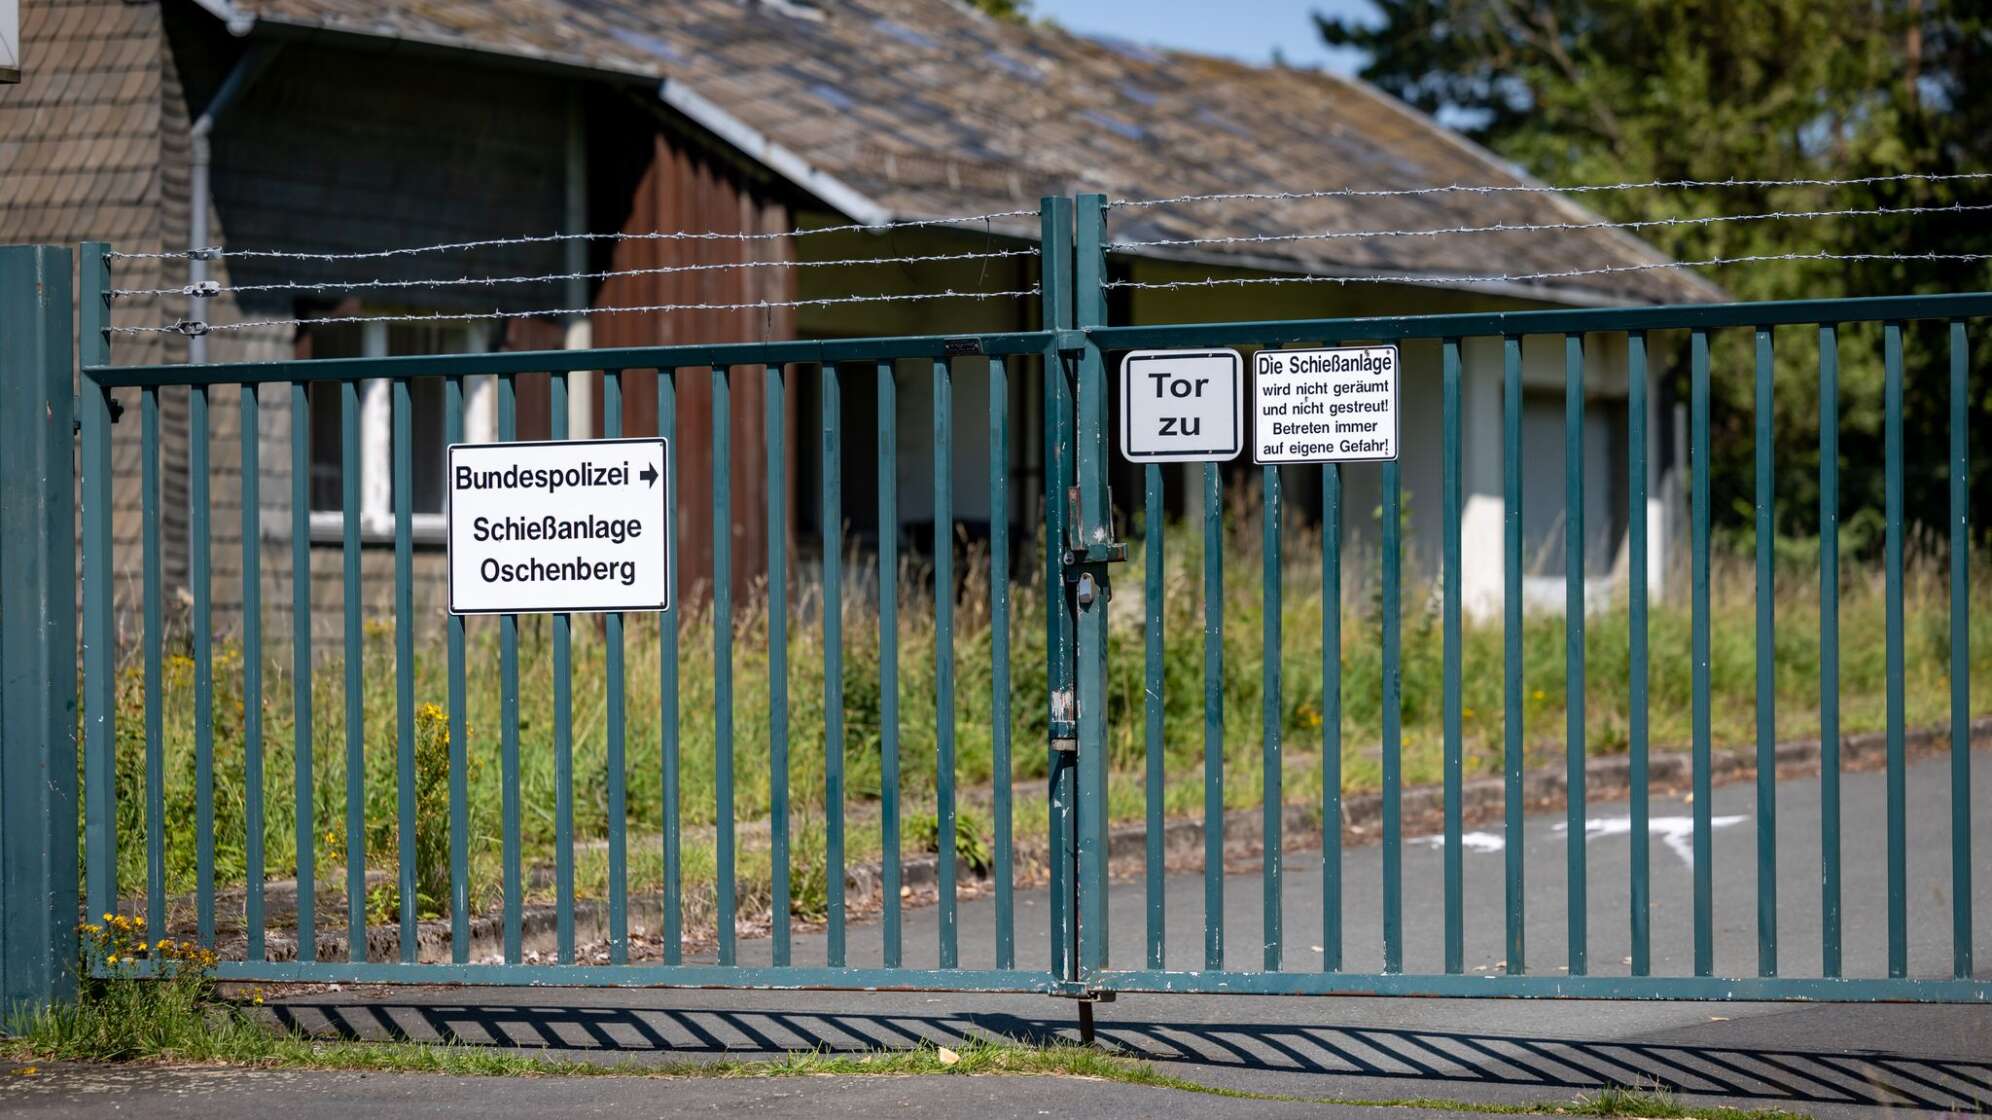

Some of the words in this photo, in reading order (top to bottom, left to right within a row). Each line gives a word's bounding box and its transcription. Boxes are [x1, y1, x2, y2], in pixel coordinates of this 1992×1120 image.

[1259, 356, 1283, 375] Die
[1289, 354, 1392, 375] Schießanlage
[1148, 372, 1209, 398] Tor
[1262, 383, 1291, 396] wird
[1296, 382, 1328, 395] nicht
[1333, 380, 1389, 397] geräumt
[1263, 402, 1287, 416] und
[1292, 401, 1324, 415] nicht
[1329, 399, 1388, 417] gestreut!
[1158, 417, 1200, 436] zu
[1273, 422, 1330, 435] Betreten
[1335, 420, 1378, 433] immer
[1263, 441, 1284, 455] auf
[1289, 441, 1334, 457] eigene
[1339, 438, 1388, 453] Gefahr!
[456, 460, 629, 494] Bundespolizei
[473, 514, 642, 544] Schießanlage
[480, 556, 636, 586] Oschenberg
